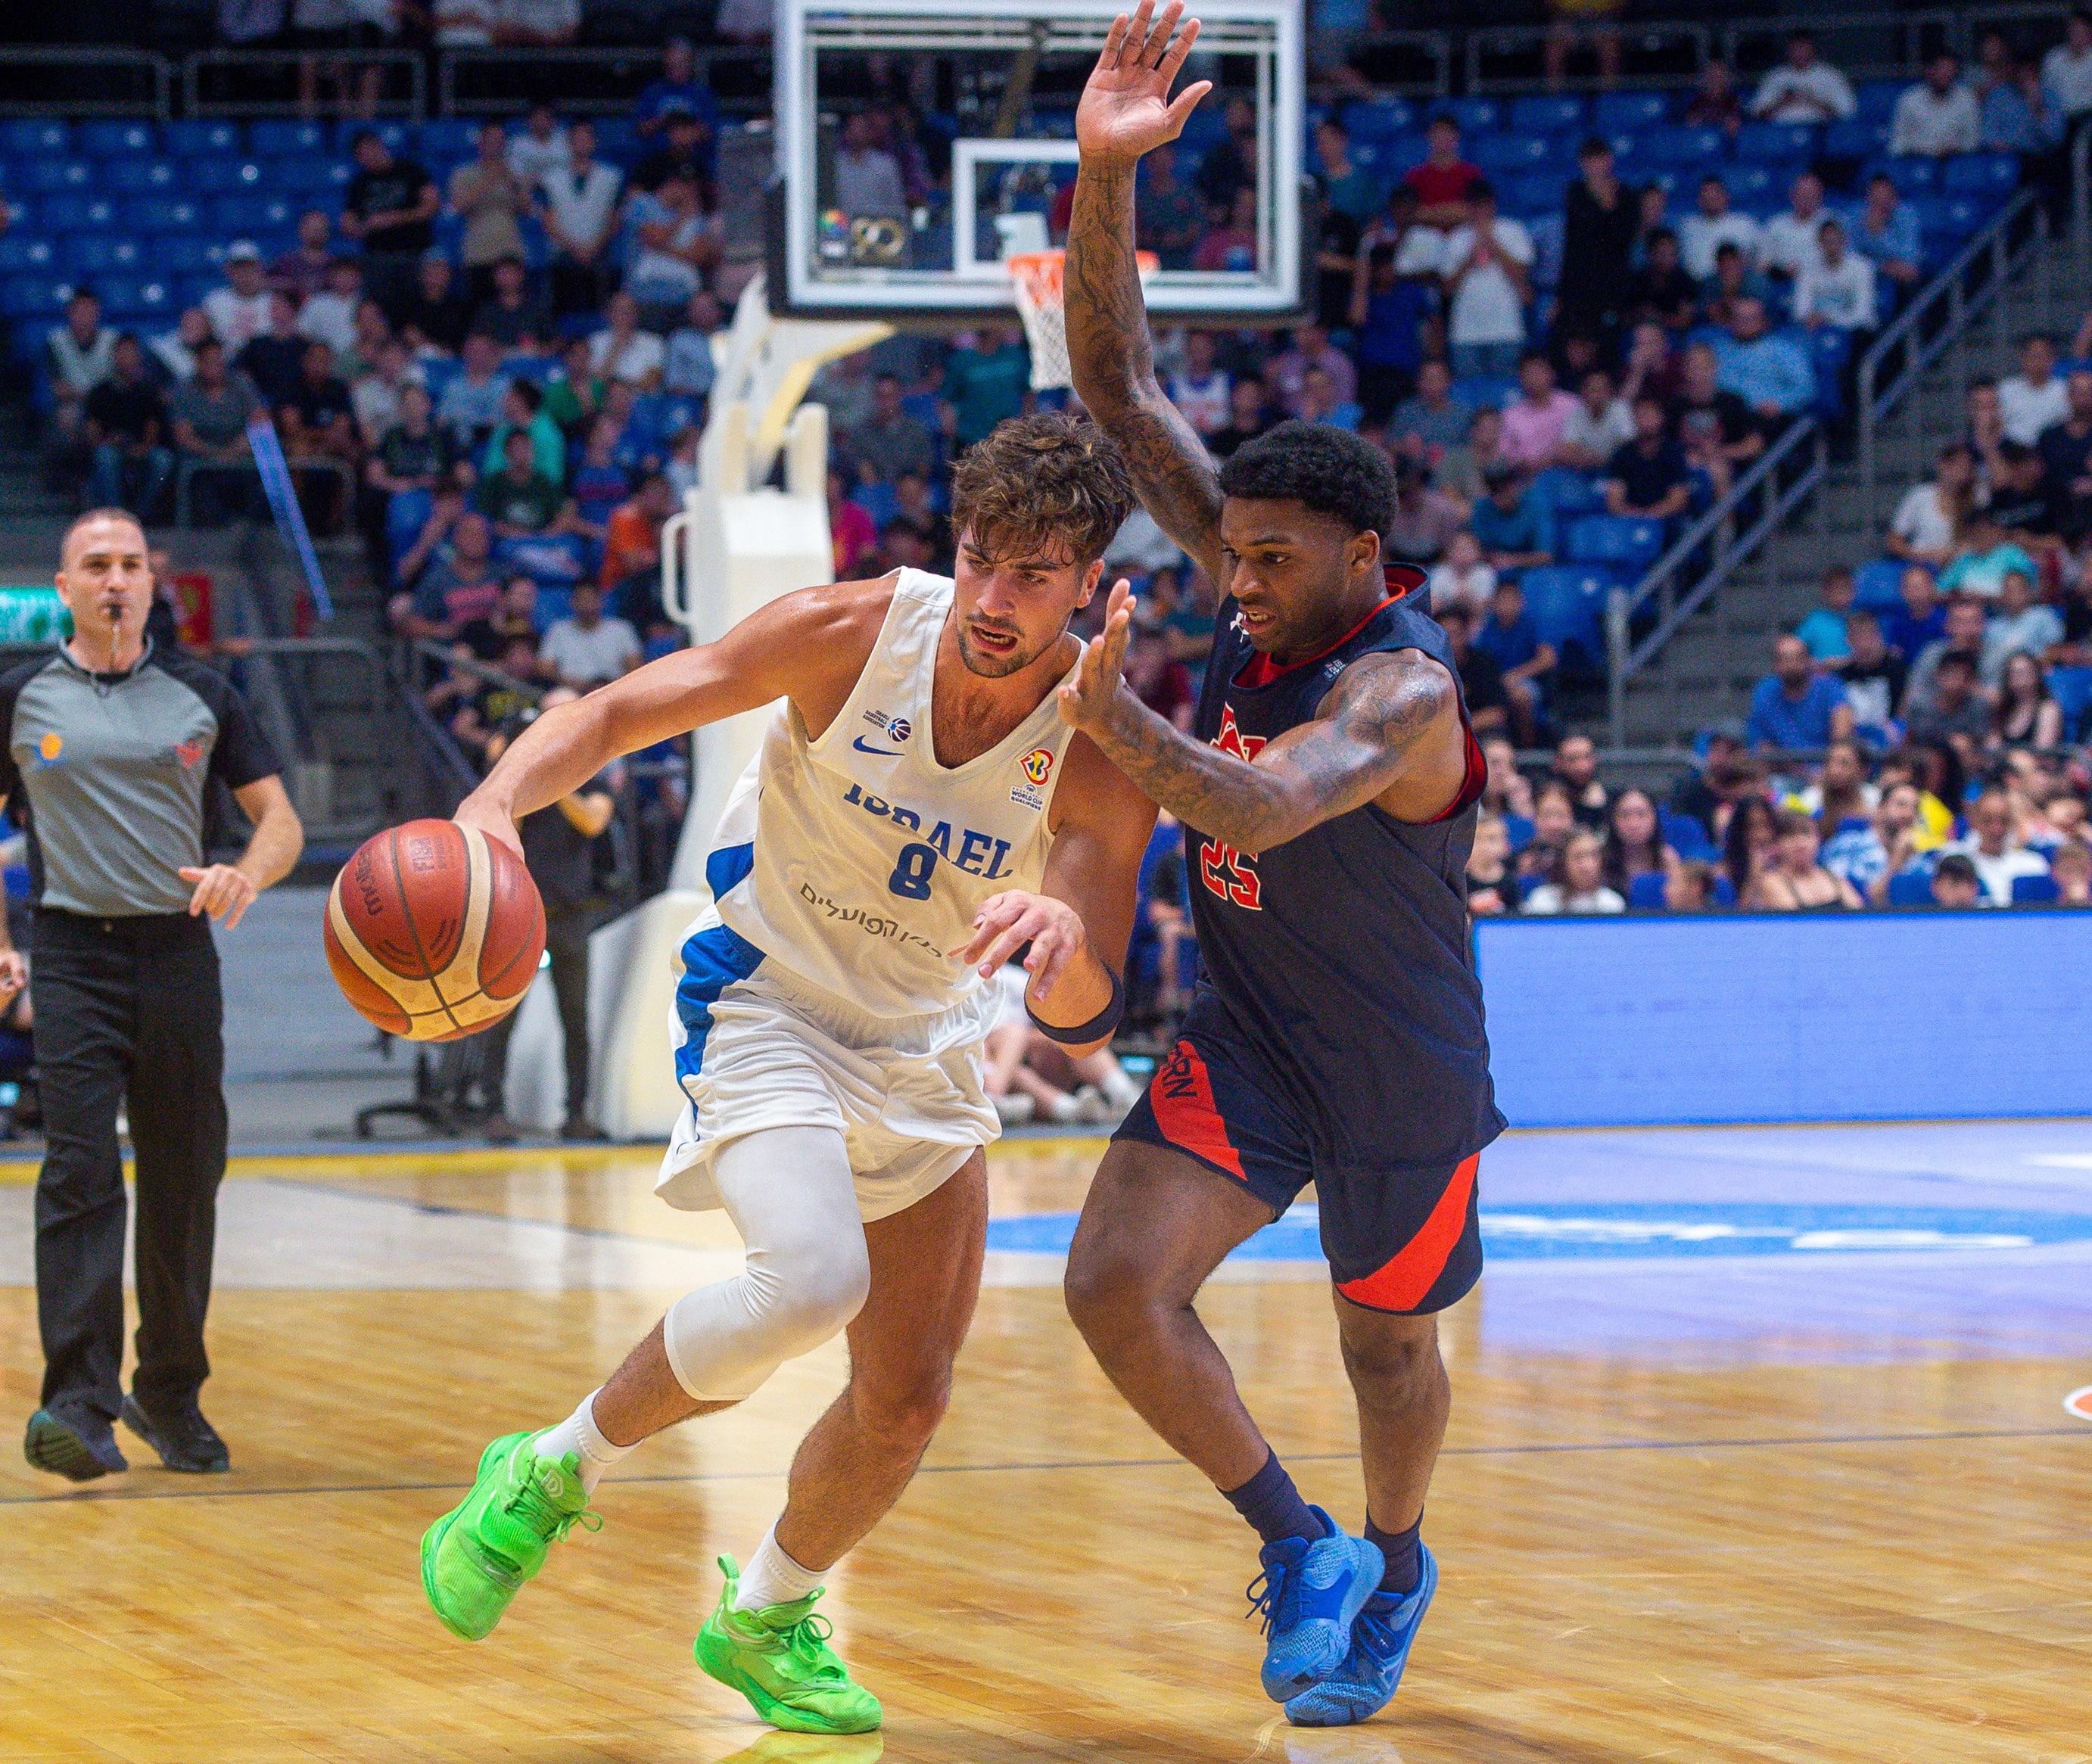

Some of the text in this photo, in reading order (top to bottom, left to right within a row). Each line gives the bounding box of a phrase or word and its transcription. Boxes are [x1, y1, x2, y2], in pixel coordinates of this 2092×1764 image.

[1010, 796, 1041, 810] QUALIFIERS
[1011, 790, 1032, 801] WORLD
[888, 842, 939, 901] 8
[800, 882, 899, 937] הפועלים
